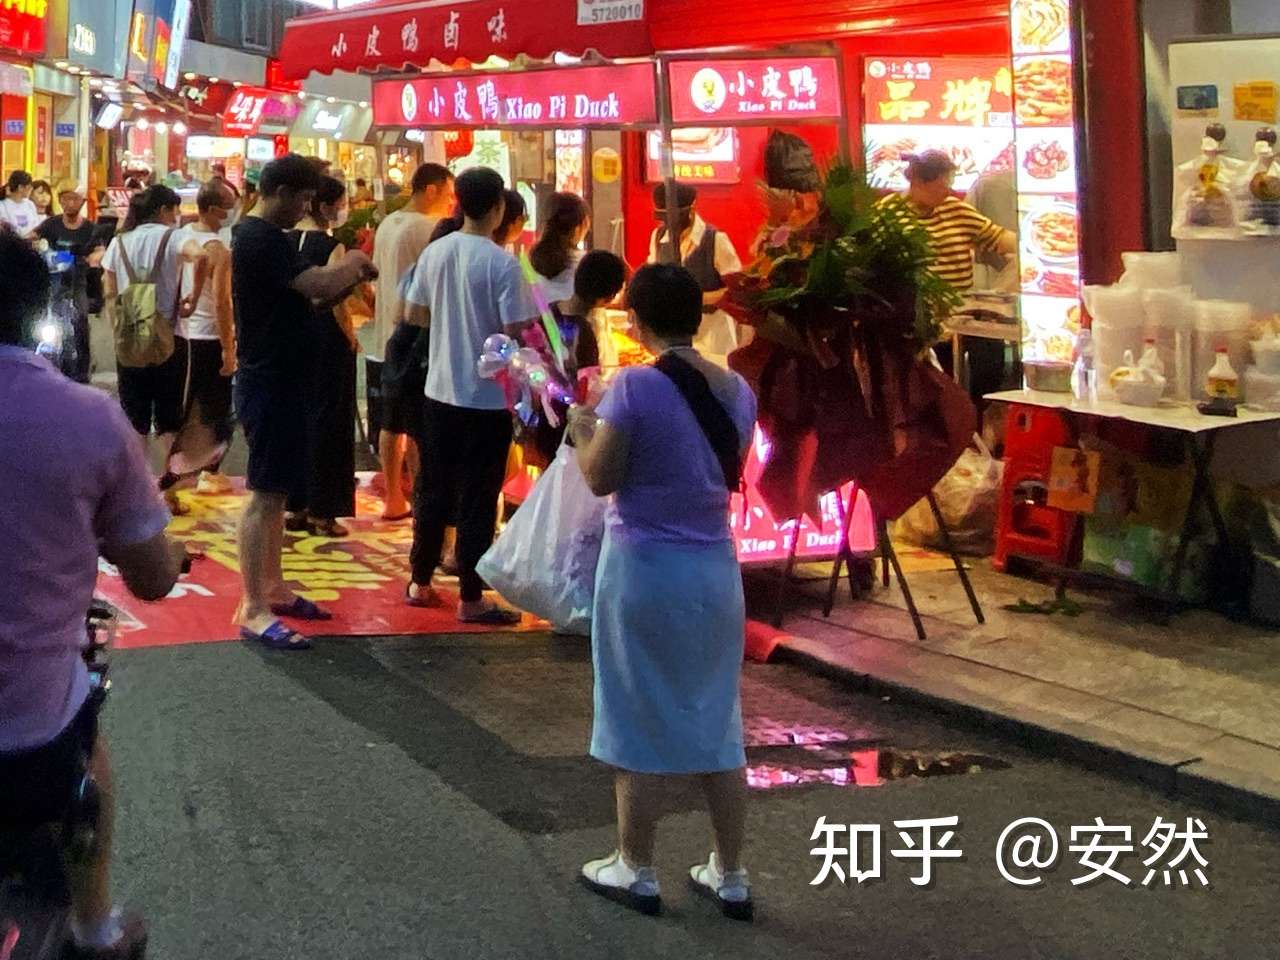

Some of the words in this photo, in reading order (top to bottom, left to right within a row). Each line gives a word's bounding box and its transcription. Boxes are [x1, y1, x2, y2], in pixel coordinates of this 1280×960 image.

[506, 97, 542, 120] Xiao
[548, 95, 567, 118] Pi
[574, 92, 620, 119] Duck
[740, 537, 777, 553] Xiao
